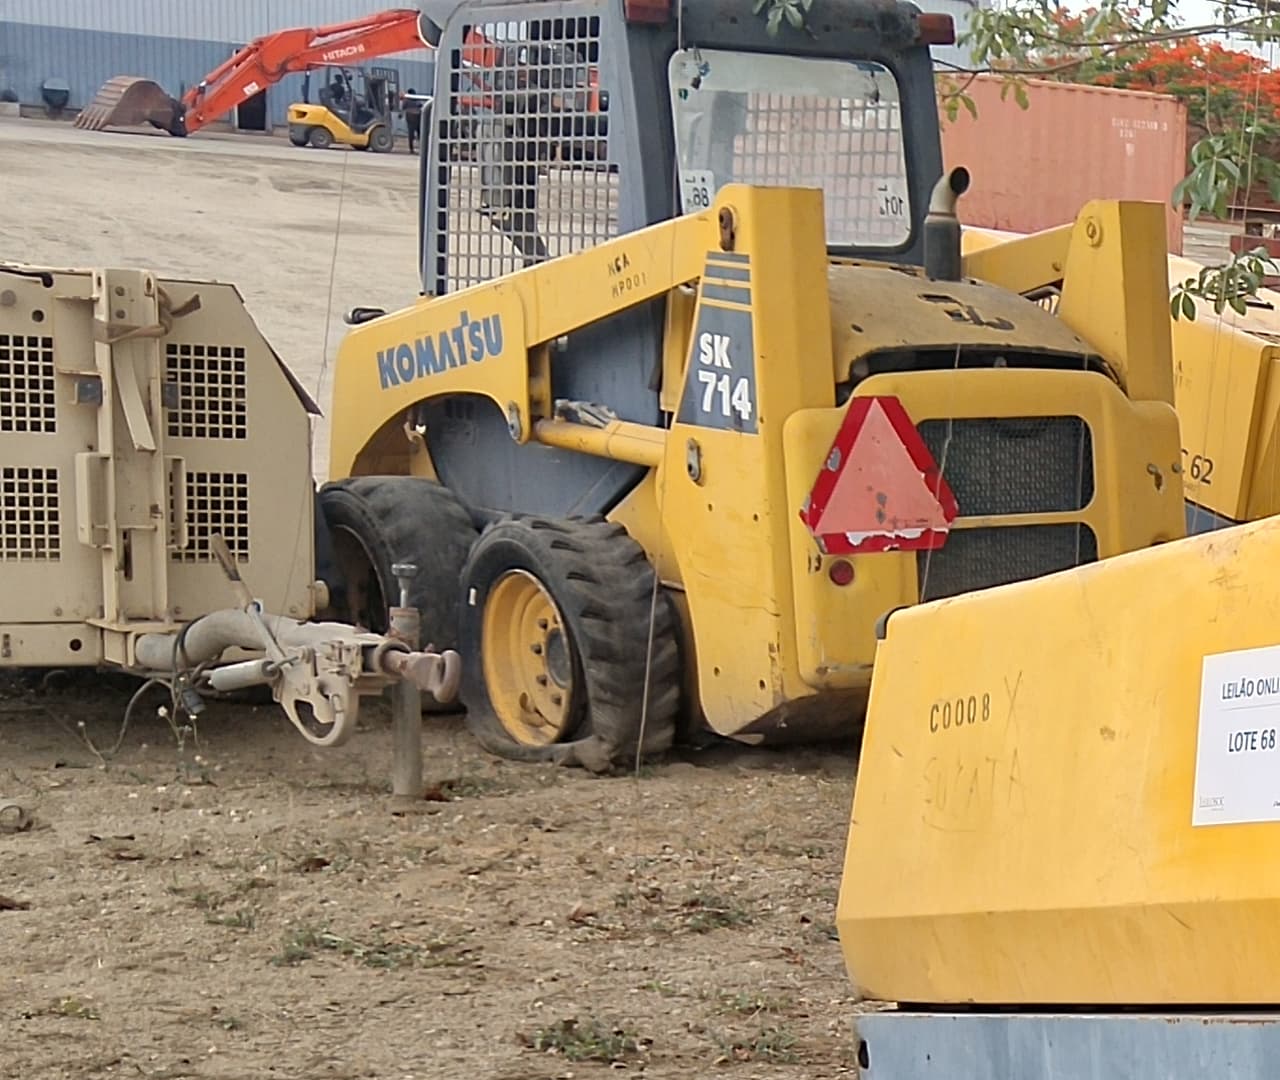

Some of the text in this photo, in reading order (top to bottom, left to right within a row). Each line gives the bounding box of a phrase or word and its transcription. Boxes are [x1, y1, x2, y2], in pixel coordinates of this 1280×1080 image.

[322, 43, 365, 61] HITACHI
[376, 310, 503, 391] KOMATSU
[699, 332, 732, 369] SK
[698, 369, 752, 420] 714
[1222, 678, 1255, 700] LEILÃO
[1229, 728, 1276, 752] LOTE 68
